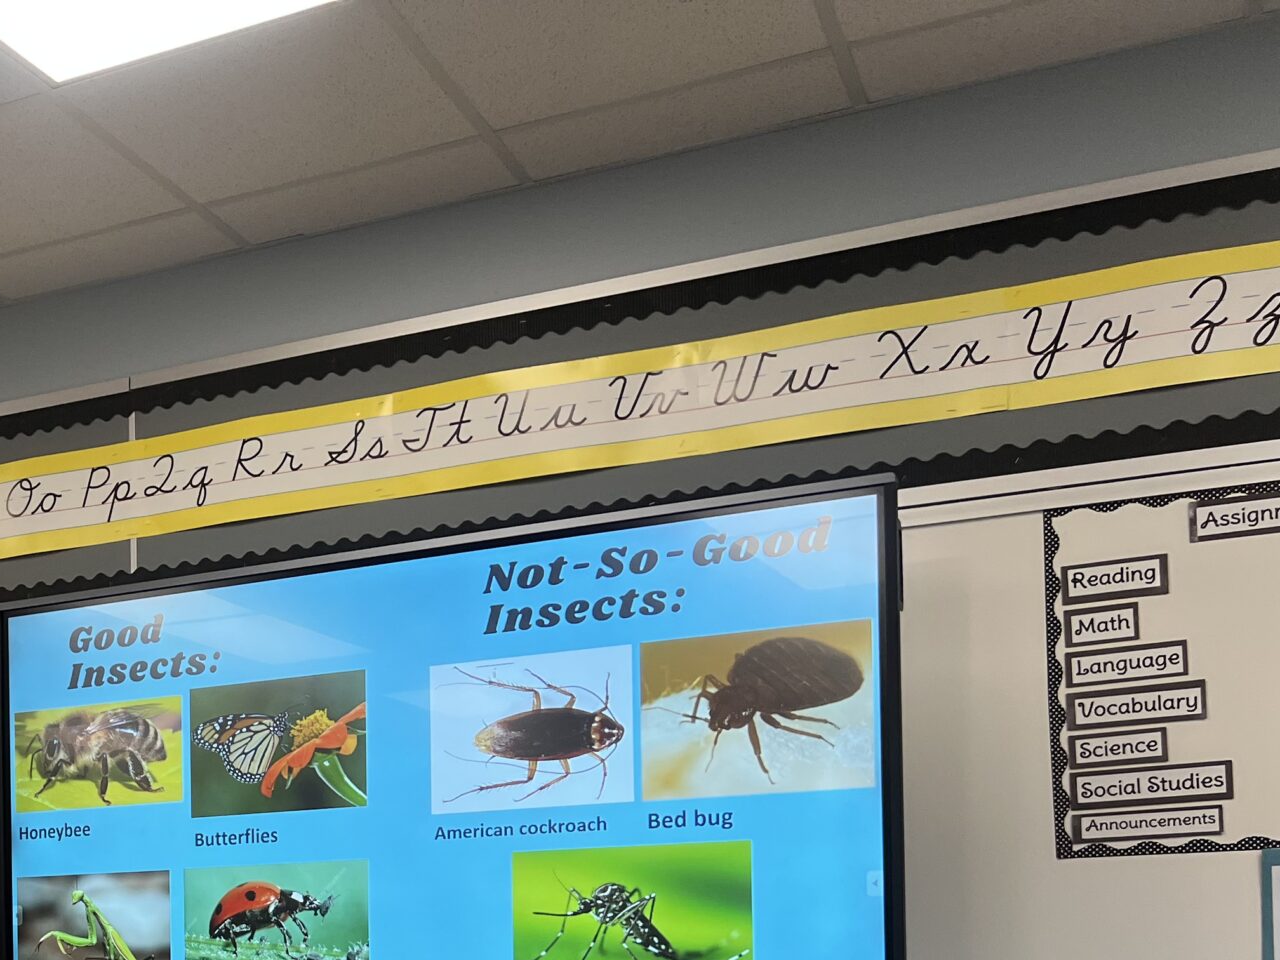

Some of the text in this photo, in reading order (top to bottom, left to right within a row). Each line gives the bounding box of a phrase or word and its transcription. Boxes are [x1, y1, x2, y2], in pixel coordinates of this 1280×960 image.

[483, 515, 834, 595] Not-So-Good
[1071, 566, 1157, 590] Reading
[483, 587, 687, 635] Insects:
[68, 613, 166, 655] Good
[1074, 614, 1131, 636] Math
[67, 650, 222, 691] Insects:
[1075, 652, 1181, 676] Language
[1077, 694, 1199, 719] Vocabulary
[1079, 739, 1159, 760] Science
[1080, 772, 1225, 799] Social Studies
[18, 822, 92, 842] Honeybee
[434, 815, 608, 842] American cockroach
[648, 810, 734, 831] Bed bug
[1085, 812, 1217, 833] Announcements
[194, 827, 279, 849] Butterflies
